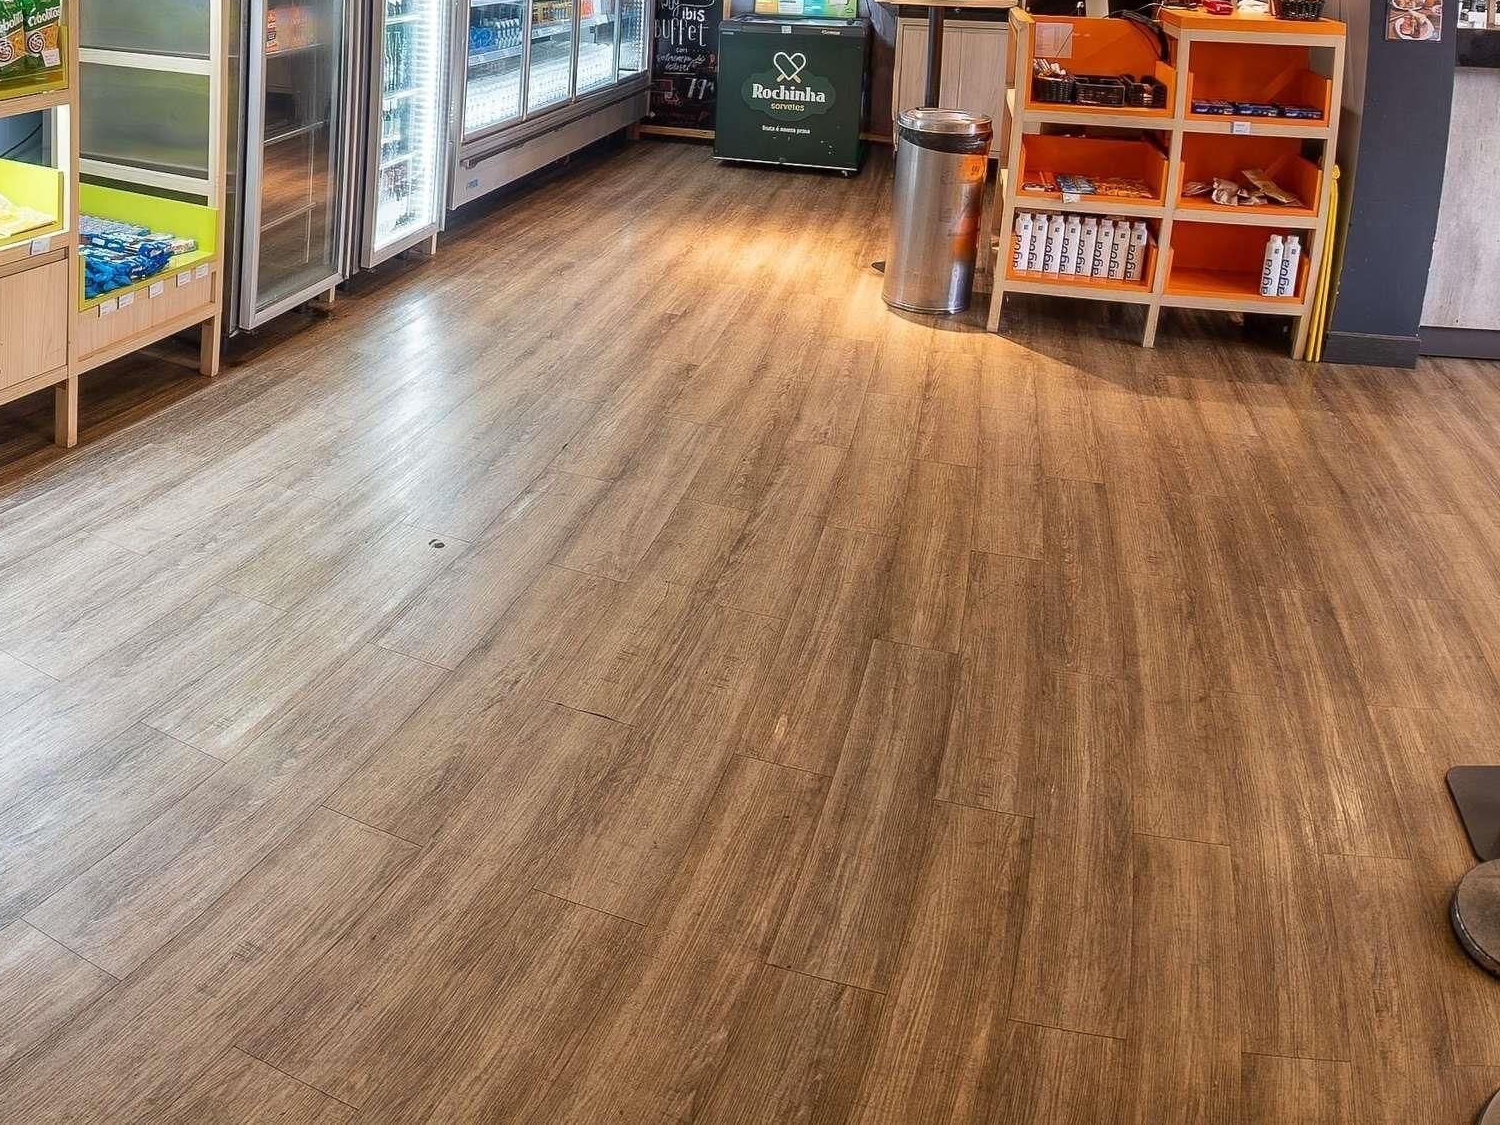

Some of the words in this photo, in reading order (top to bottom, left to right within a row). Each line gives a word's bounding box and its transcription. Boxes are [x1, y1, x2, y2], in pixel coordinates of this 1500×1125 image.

[682, 7, 706, 23] ibis
[752, 83, 826, 103] Rochinha
[770, 103, 805, 113] sorvetes
